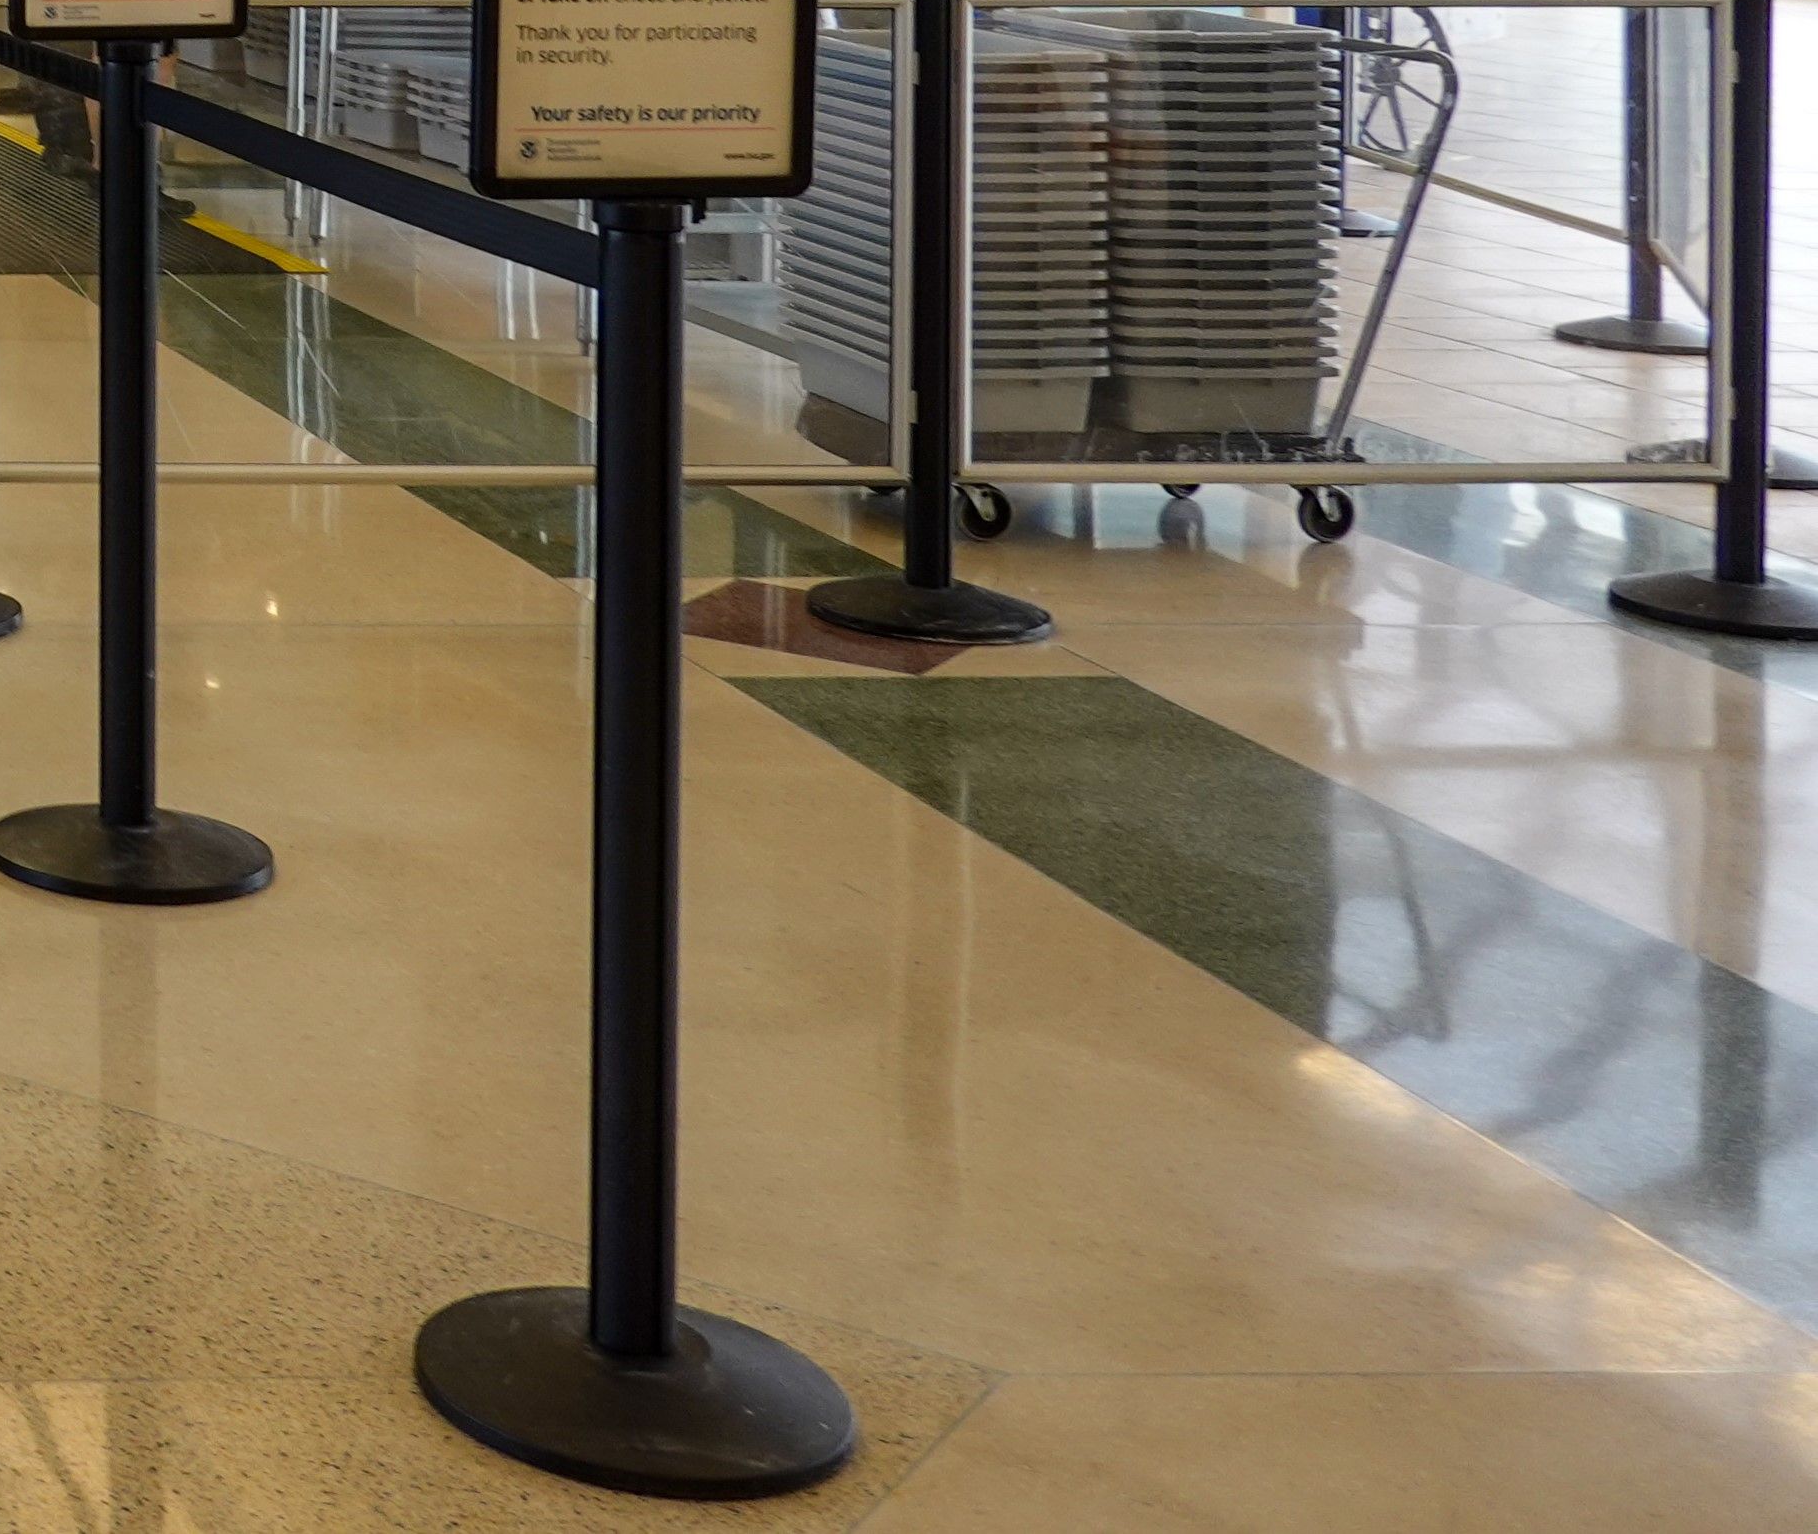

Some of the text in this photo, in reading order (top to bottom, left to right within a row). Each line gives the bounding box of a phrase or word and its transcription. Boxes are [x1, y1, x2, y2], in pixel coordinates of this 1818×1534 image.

[515, 24, 758, 45] Thank you for participating
[515, 47, 614, 67] in security.
[530, 105, 572, 122] Your
[577, 105, 633, 126] safety
[637, 104, 652, 122] is
[691, 104, 762, 126] priority
